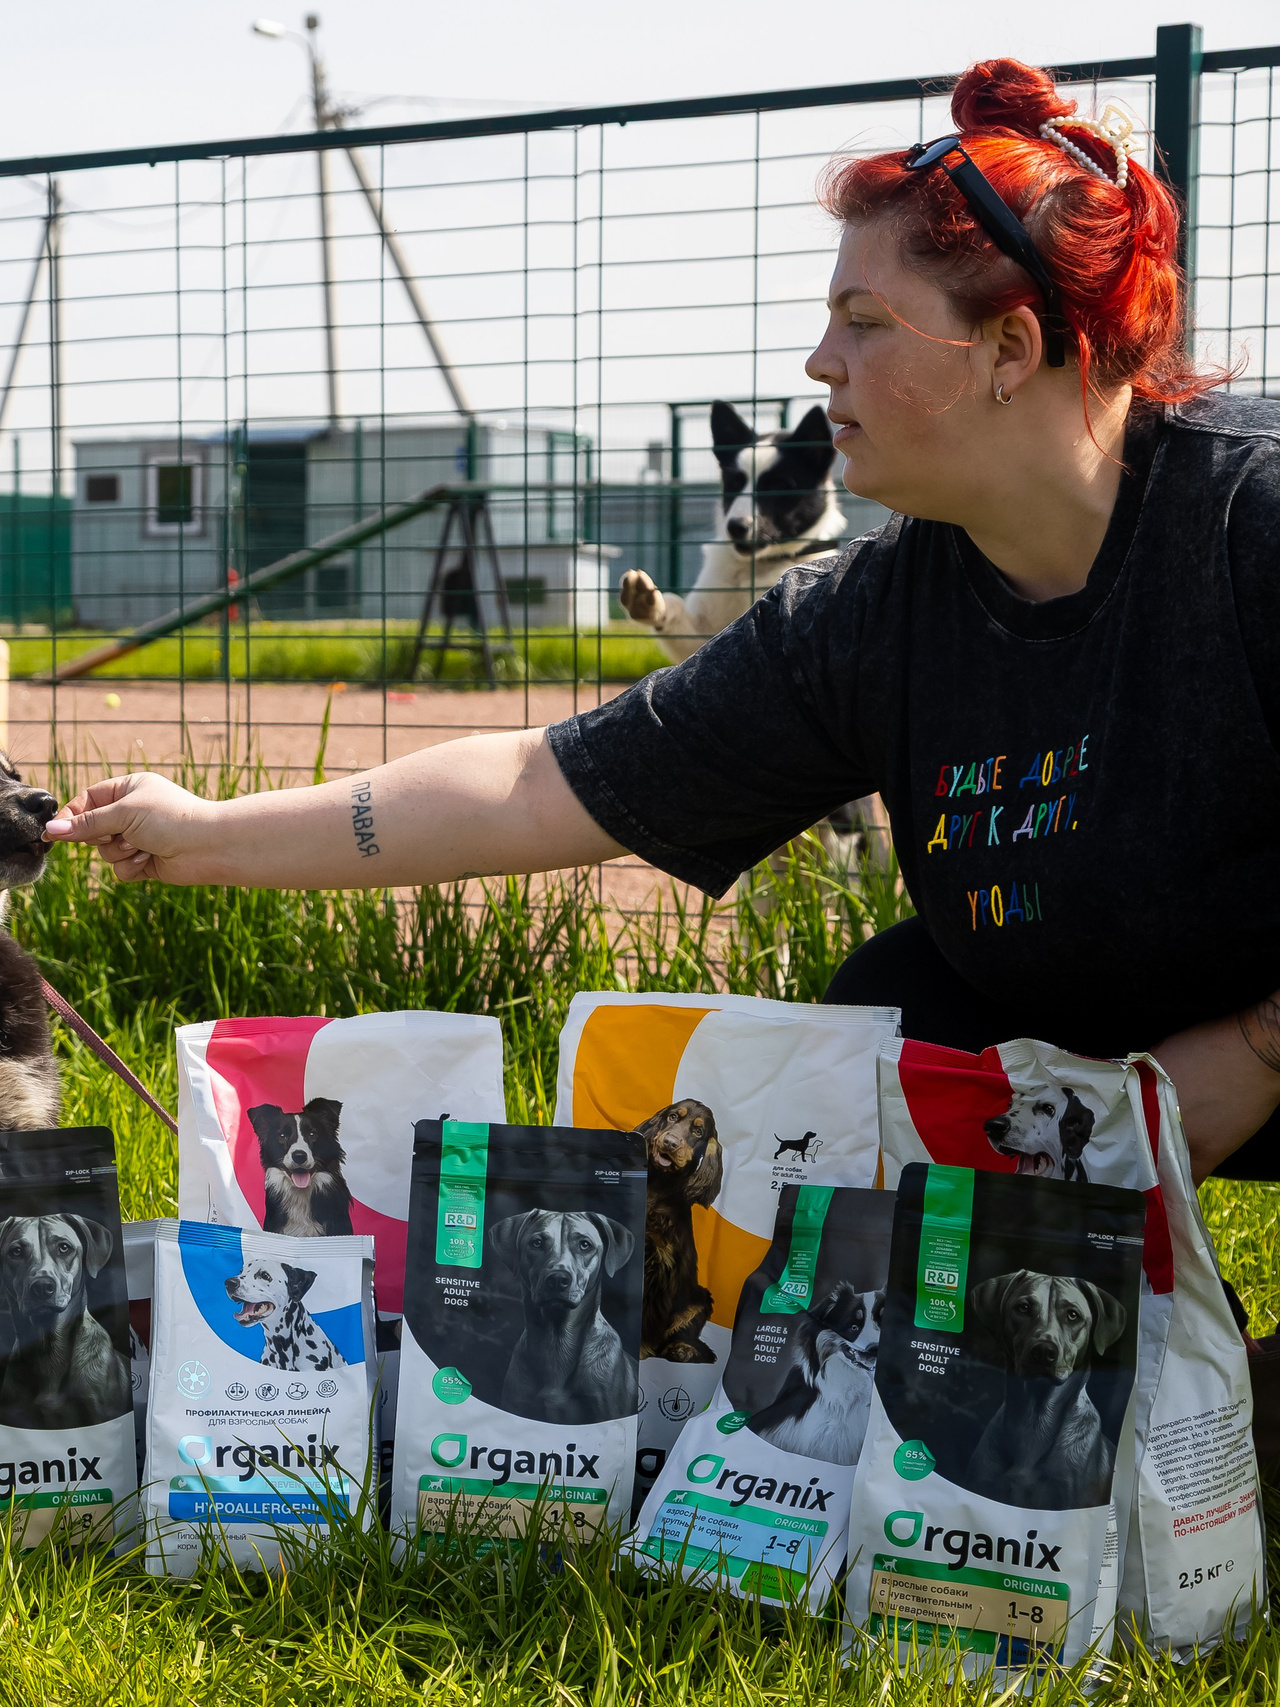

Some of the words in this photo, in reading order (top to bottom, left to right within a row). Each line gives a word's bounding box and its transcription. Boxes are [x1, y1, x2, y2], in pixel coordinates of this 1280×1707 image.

[935, 755, 1006, 797] БУДЬТЕ
[1020, 734, 1089, 788] ДОБРЕЕ
[351, 781, 380, 858] ПРАВАЯ
[927, 810, 983, 853] ДРУГ
[987, 805, 1004, 846] К
[967, 881, 1043, 931] УРОДЫ
[594, 1169, 620, 1177] ZIP-LOCK
[447, 1214, 474, 1225] R&D
[1087, 1232, 1115, 1241] ZIP-LOCK
[435, 1276, 481, 1289] SENSITIVE
[927, 1270, 956, 1285] R&D
[443, 1287, 471, 1297] ADULT
[784, 1282, 807, 1295] R&D
[444, 1297, 469, 1307] DOGS
[756, 1325, 781, 1333] LARGE
[754, 1334, 786, 1345] MEDIUM
[754, 1344, 781, 1354] ADULT
[910, 1340, 960, 1356] SENSITIVE
[754, 1354, 777, 1364] DOGS
[918, 1353, 950, 1364] ADULT
[918, 1364, 945, 1375] DOGS
[442, 1376, 463, 1385] 65%
[185, 1408, 285, 1417] ПРОФИЛАКТИЧЕСКАЯ
[287, 1407, 331, 1416] ЛИНЕЙКА
[208, 1418, 227, 1427] ДЛЯ
[228, 1418, 276, 1426] ВЗРОСЛЫХ
[278, 1417, 309, 1425] СОБАК
[1152, 1416, 1192, 1433] прекрасно
[1192, 1409, 1218, 1421] знаем,
[1168, 1425, 1194, 1437] своего
[1152, 1436, 1191, 1452] здоровым.
[1191, 1431, 1203, 1440] Но
[905, 1450, 927, 1460] 65%
[1150, 1445, 1188, 1460] городской
[1188, 1439, 1212, 1452] среды
[177, 1433, 340, 1482] Organix
[431, 1433, 600, 1486] Organix
[1153, 1454, 1193, 1469] оставаться
[1193, 1446, 1221, 1459] полным
[1156, 1464, 1185, 1478] Именно
[1185, 1457, 1215, 1470] поэтому
[686, 1453, 836, 1512] Organix
[1160, 1473, 1189, 1487] Organix,
[1164, 1477, 1211, 1494] ингредиентов,
[1176, 1496, 1211, 1511] счастливой
[666, 1508, 707, 1522] взрослые
[708, 1515, 739, 1530] собаки
[1173, 1513, 1205, 1529] ДАВАТЬ
[1205, 1501, 1232, 1519] ЛУЧШЕЕ
[774, 1517, 820, 1533] ORIGINAL
[1174, 1510, 1237, 1538] ПО-НАСТОЯЩЕМУ
[655, 1526, 681, 1538] пород
[706, 1527, 743, 1542] средних
[177, 1543, 198, 1551] корм
[884, 1510, 1063, 1572] Organix
[1178, 1567, 1204, 1590] 2,5
[1207, 1564, 1223, 1580] кг
[881, 1577, 928, 1592] взрослые
[930, 1583, 969, 1598] собаки
[1003, 1578, 1059, 1597] ORIGINAL
[879, 1589, 885, 1597] с
[889, 1591, 973, 1611] чувствительным
